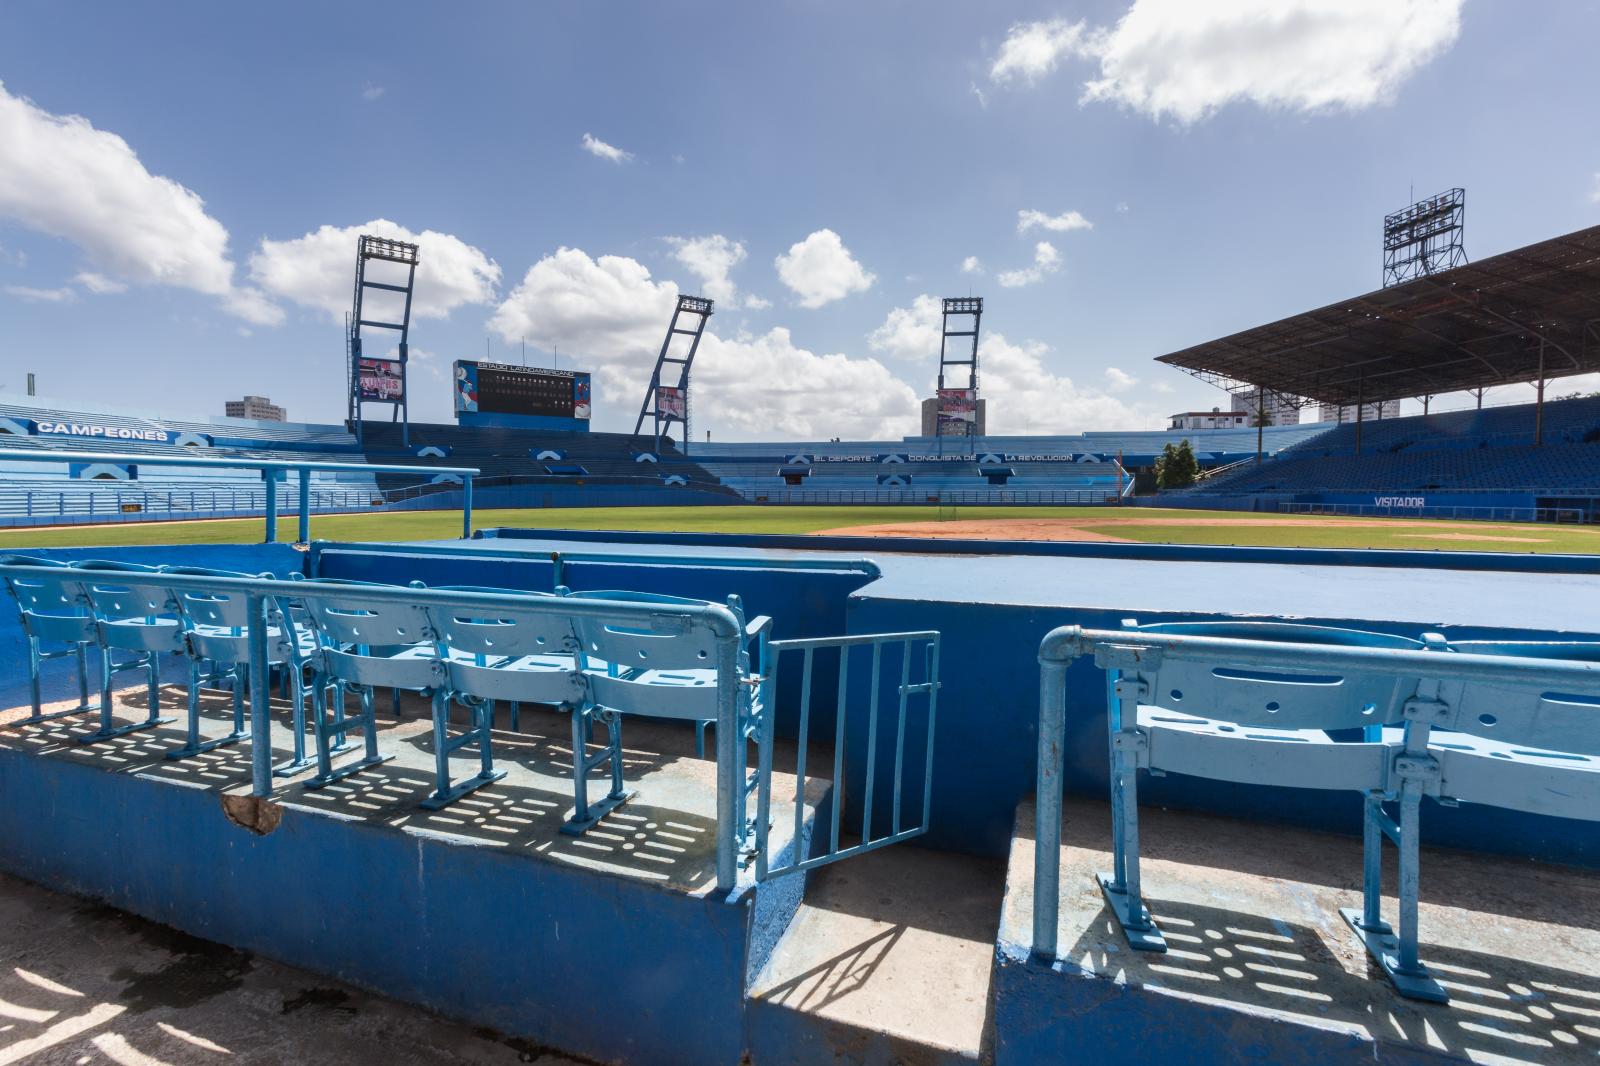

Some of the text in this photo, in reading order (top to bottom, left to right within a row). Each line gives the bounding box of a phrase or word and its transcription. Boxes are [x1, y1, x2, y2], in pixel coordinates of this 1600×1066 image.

[478, 361, 574, 377] ESTADIO LATINOAMERICANO
[37, 421, 168, 442] CAMPEONES
[1374, 496, 1425, 508] VISITADOR
